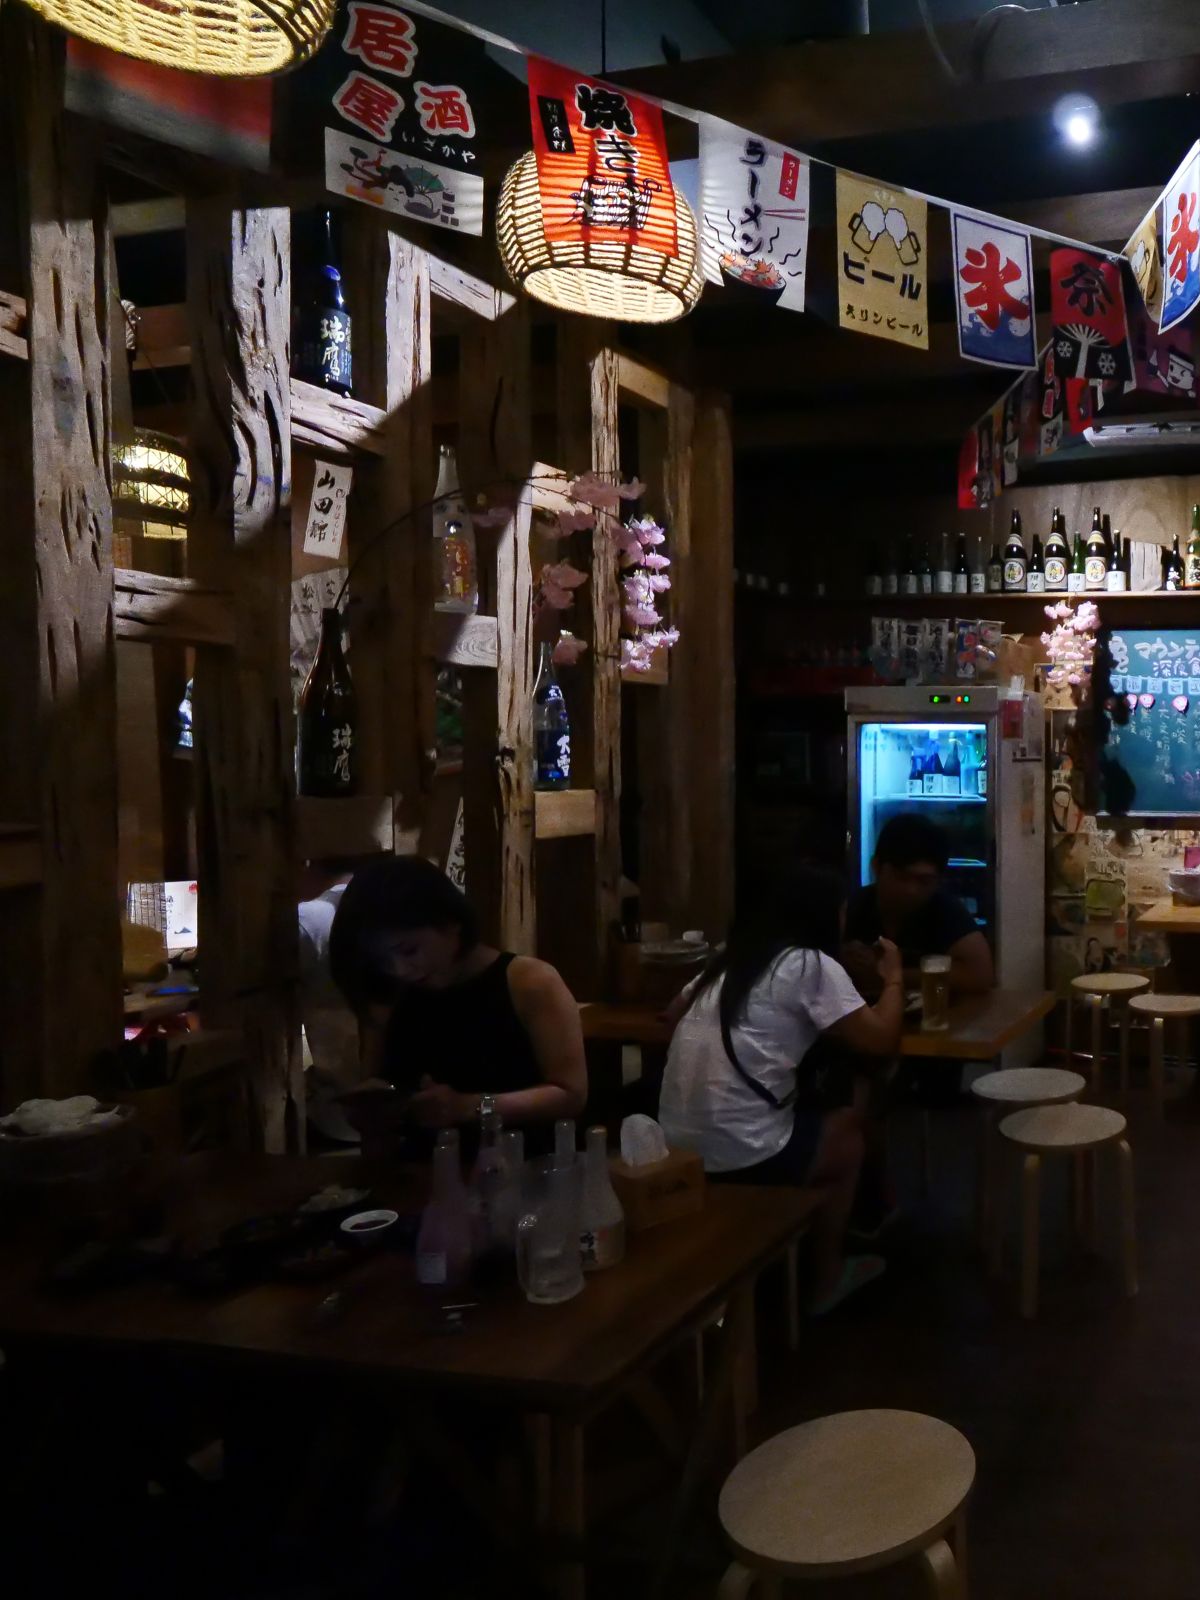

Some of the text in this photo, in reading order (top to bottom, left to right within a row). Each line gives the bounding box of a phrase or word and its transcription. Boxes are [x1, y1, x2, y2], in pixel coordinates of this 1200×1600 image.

[340, 3, 475, 141] 居酒屋
[402, 130, 476, 163] いざかや
[740, 138, 765, 256] ラーメン
[843, 251, 922, 300] ビール
[960, 241, 1030, 331] 氷
[1060, 262, 1113, 316] 祭
